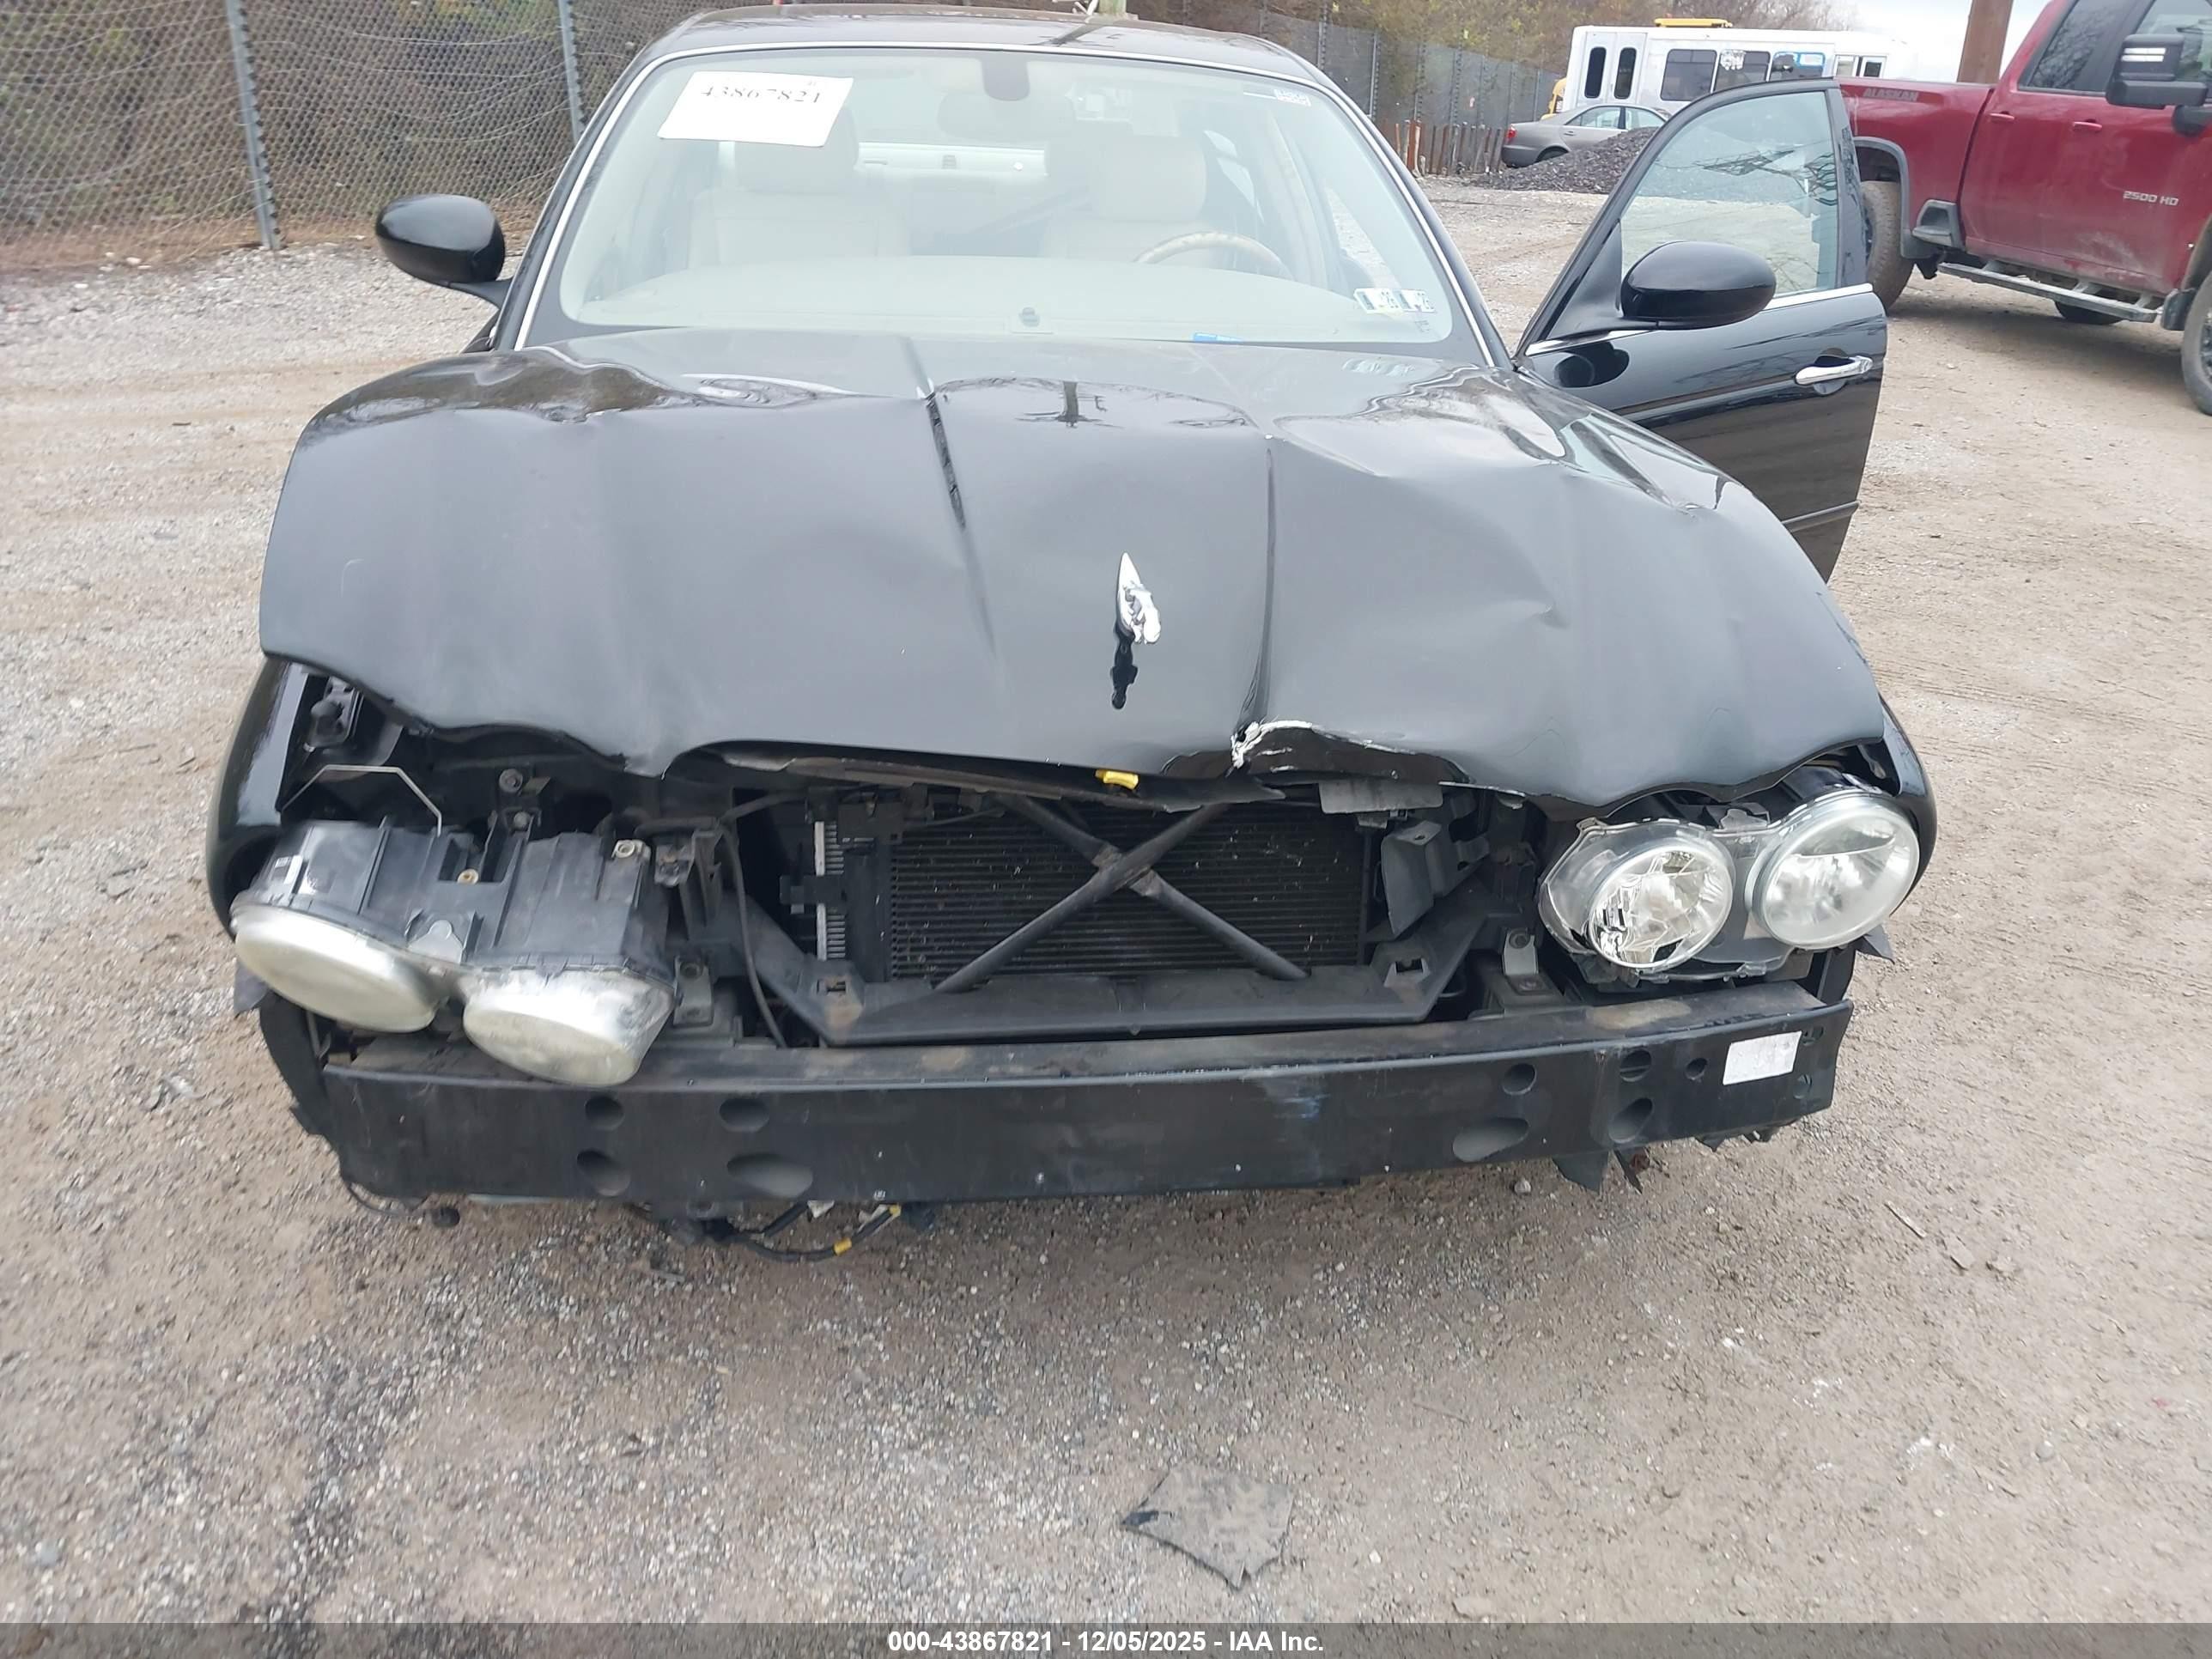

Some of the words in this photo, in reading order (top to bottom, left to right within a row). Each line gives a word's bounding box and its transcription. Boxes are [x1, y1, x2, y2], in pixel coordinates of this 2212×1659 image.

[1862, 88, 1919, 102] ALASKAN
[2122, 190, 2158, 204] 2500
[2159, 196, 2179, 206] HD
